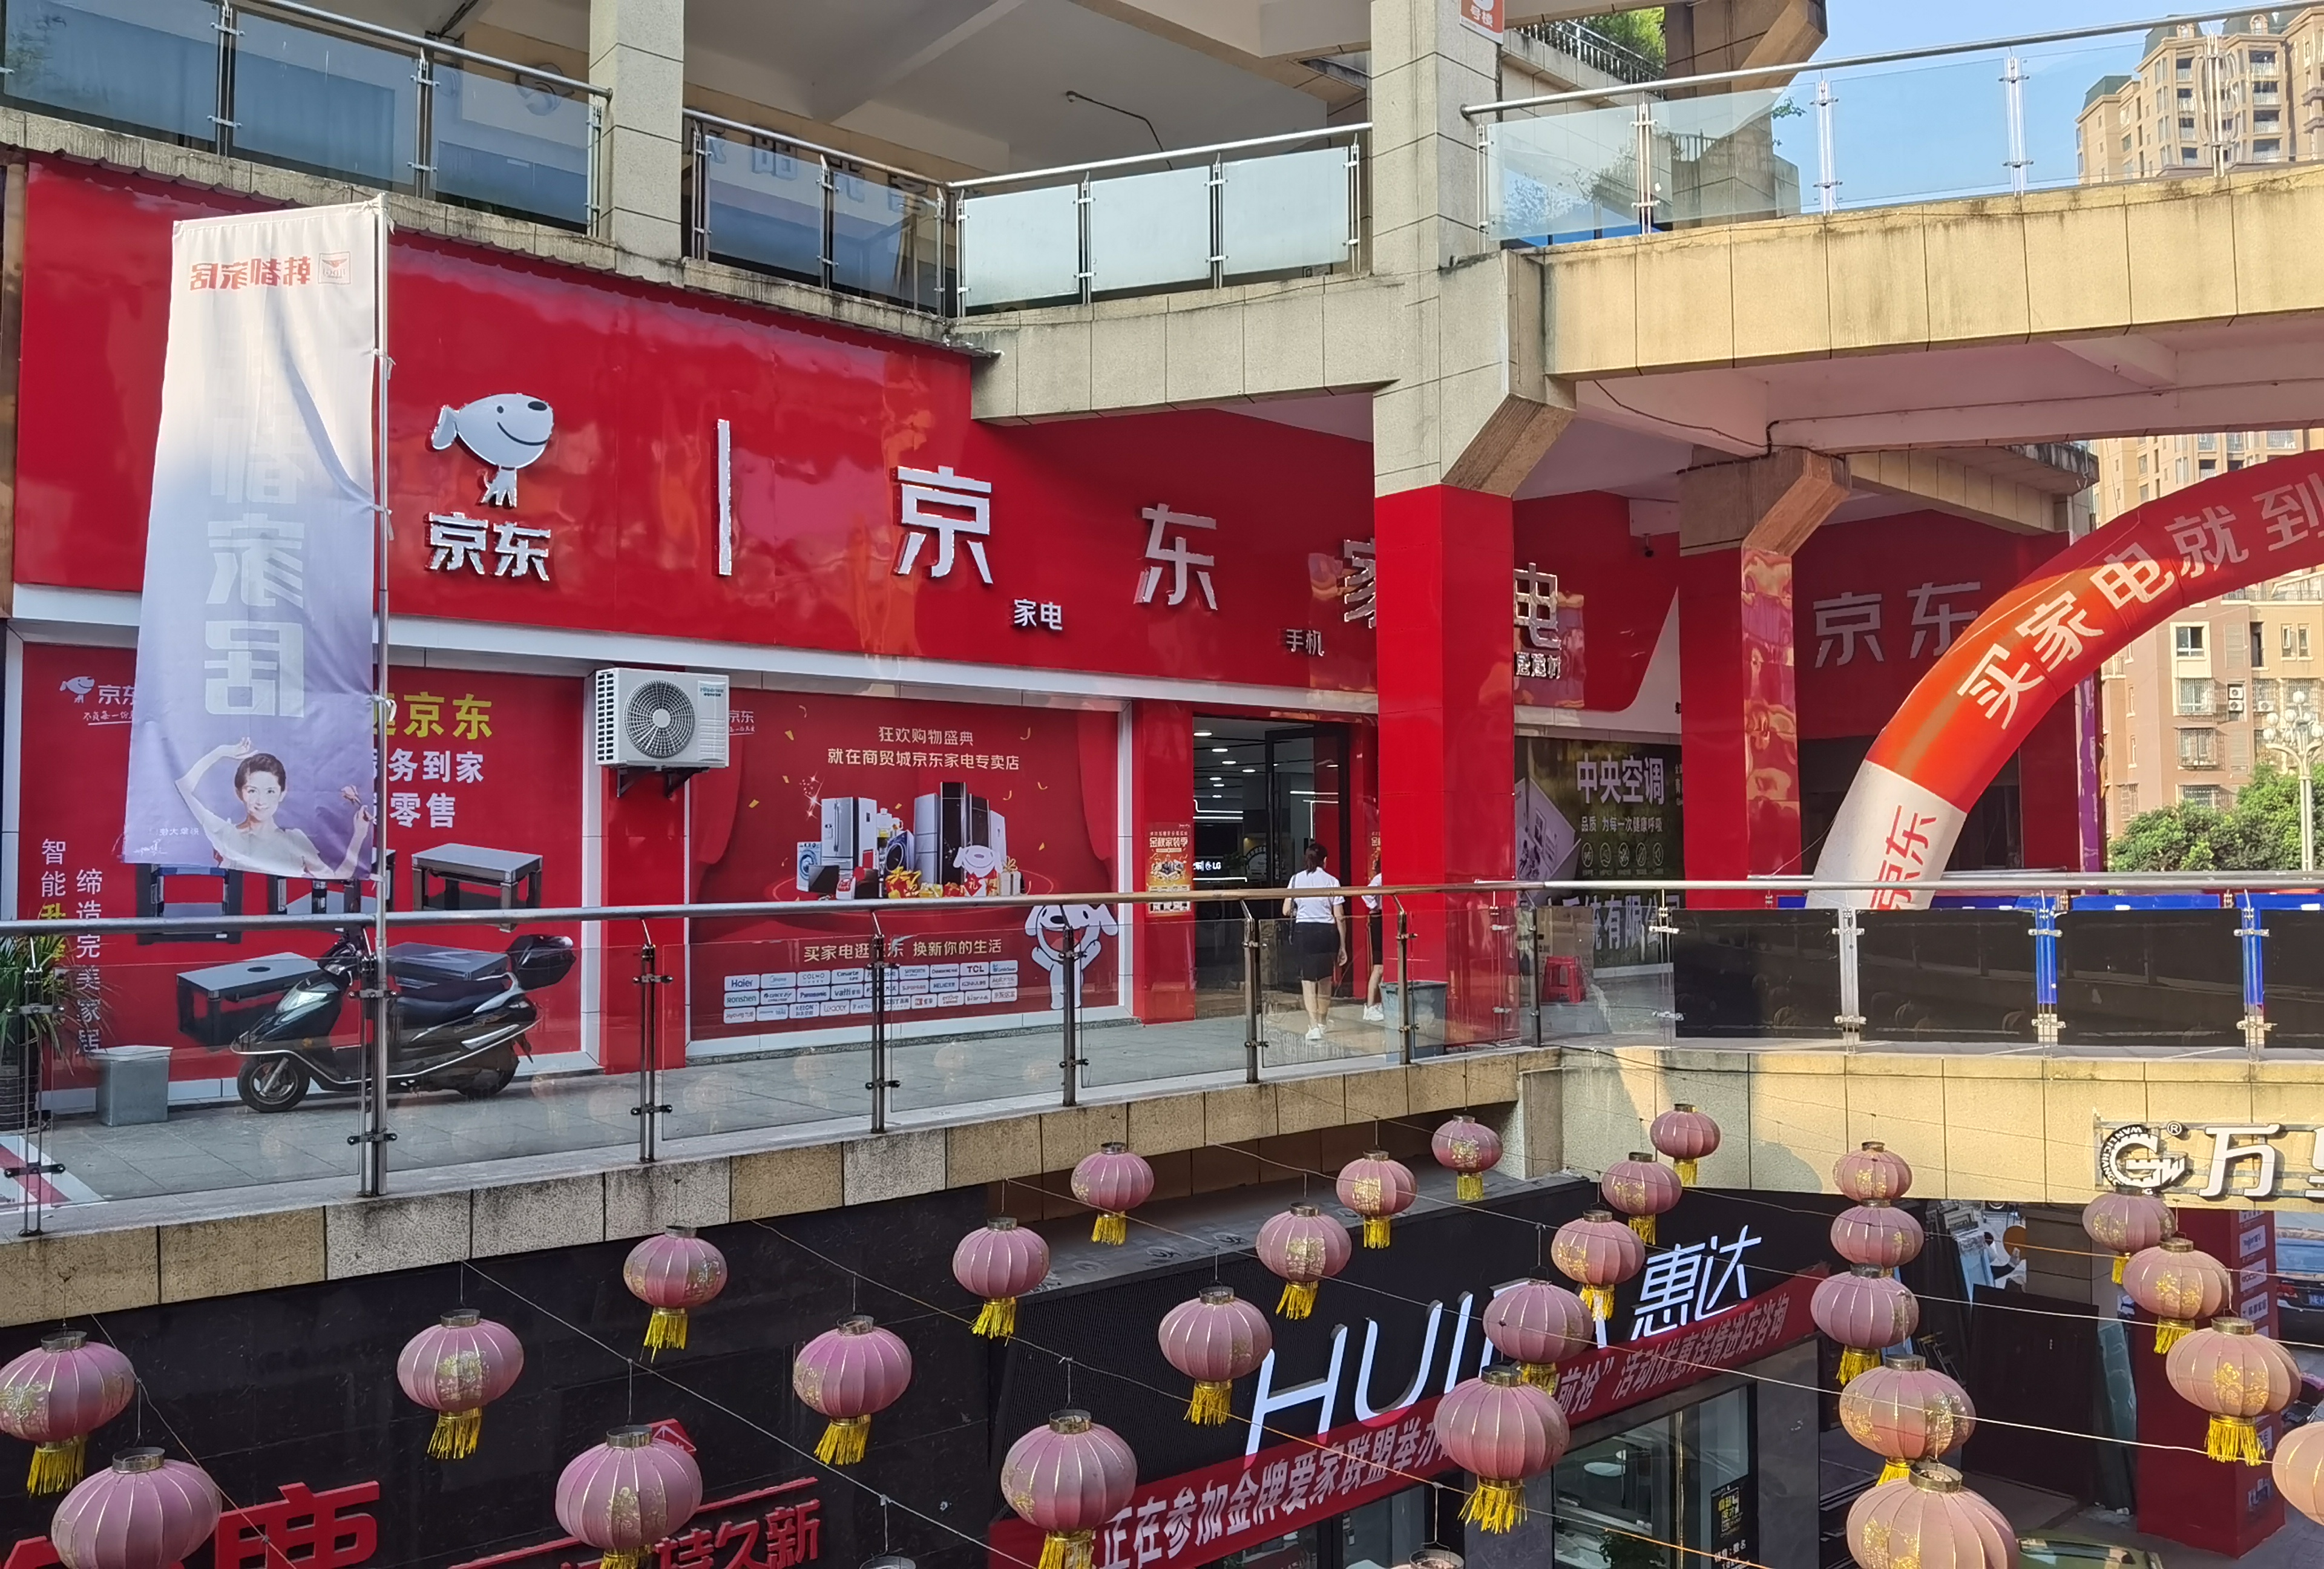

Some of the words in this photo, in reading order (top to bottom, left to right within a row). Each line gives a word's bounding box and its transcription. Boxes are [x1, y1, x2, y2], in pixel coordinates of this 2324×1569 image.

[427, 512, 551, 582] 京东
[1013, 599, 1062, 631] 家电
[1285, 628, 1325, 657] 手机
[878, 726, 974, 747] 狂欢购物盛典
[373, 748, 484, 783] 务到家
[827, 748, 1019, 771] 就在商贸城京东家电专卖店
[1577, 752, 1664, 806] 中央空调
[373, 792, 455, 829] 零售
[1581, 815, 1597, 832] 品质
[804, 942, 904, 962] 买家电逛东
[913, 939, 1002, 957] 换新你的生活
[731, 976, 753, 987] Haier
[967, 964, 984, 973] TCL
[1632, 1225, 1762, 1341] 惠达
